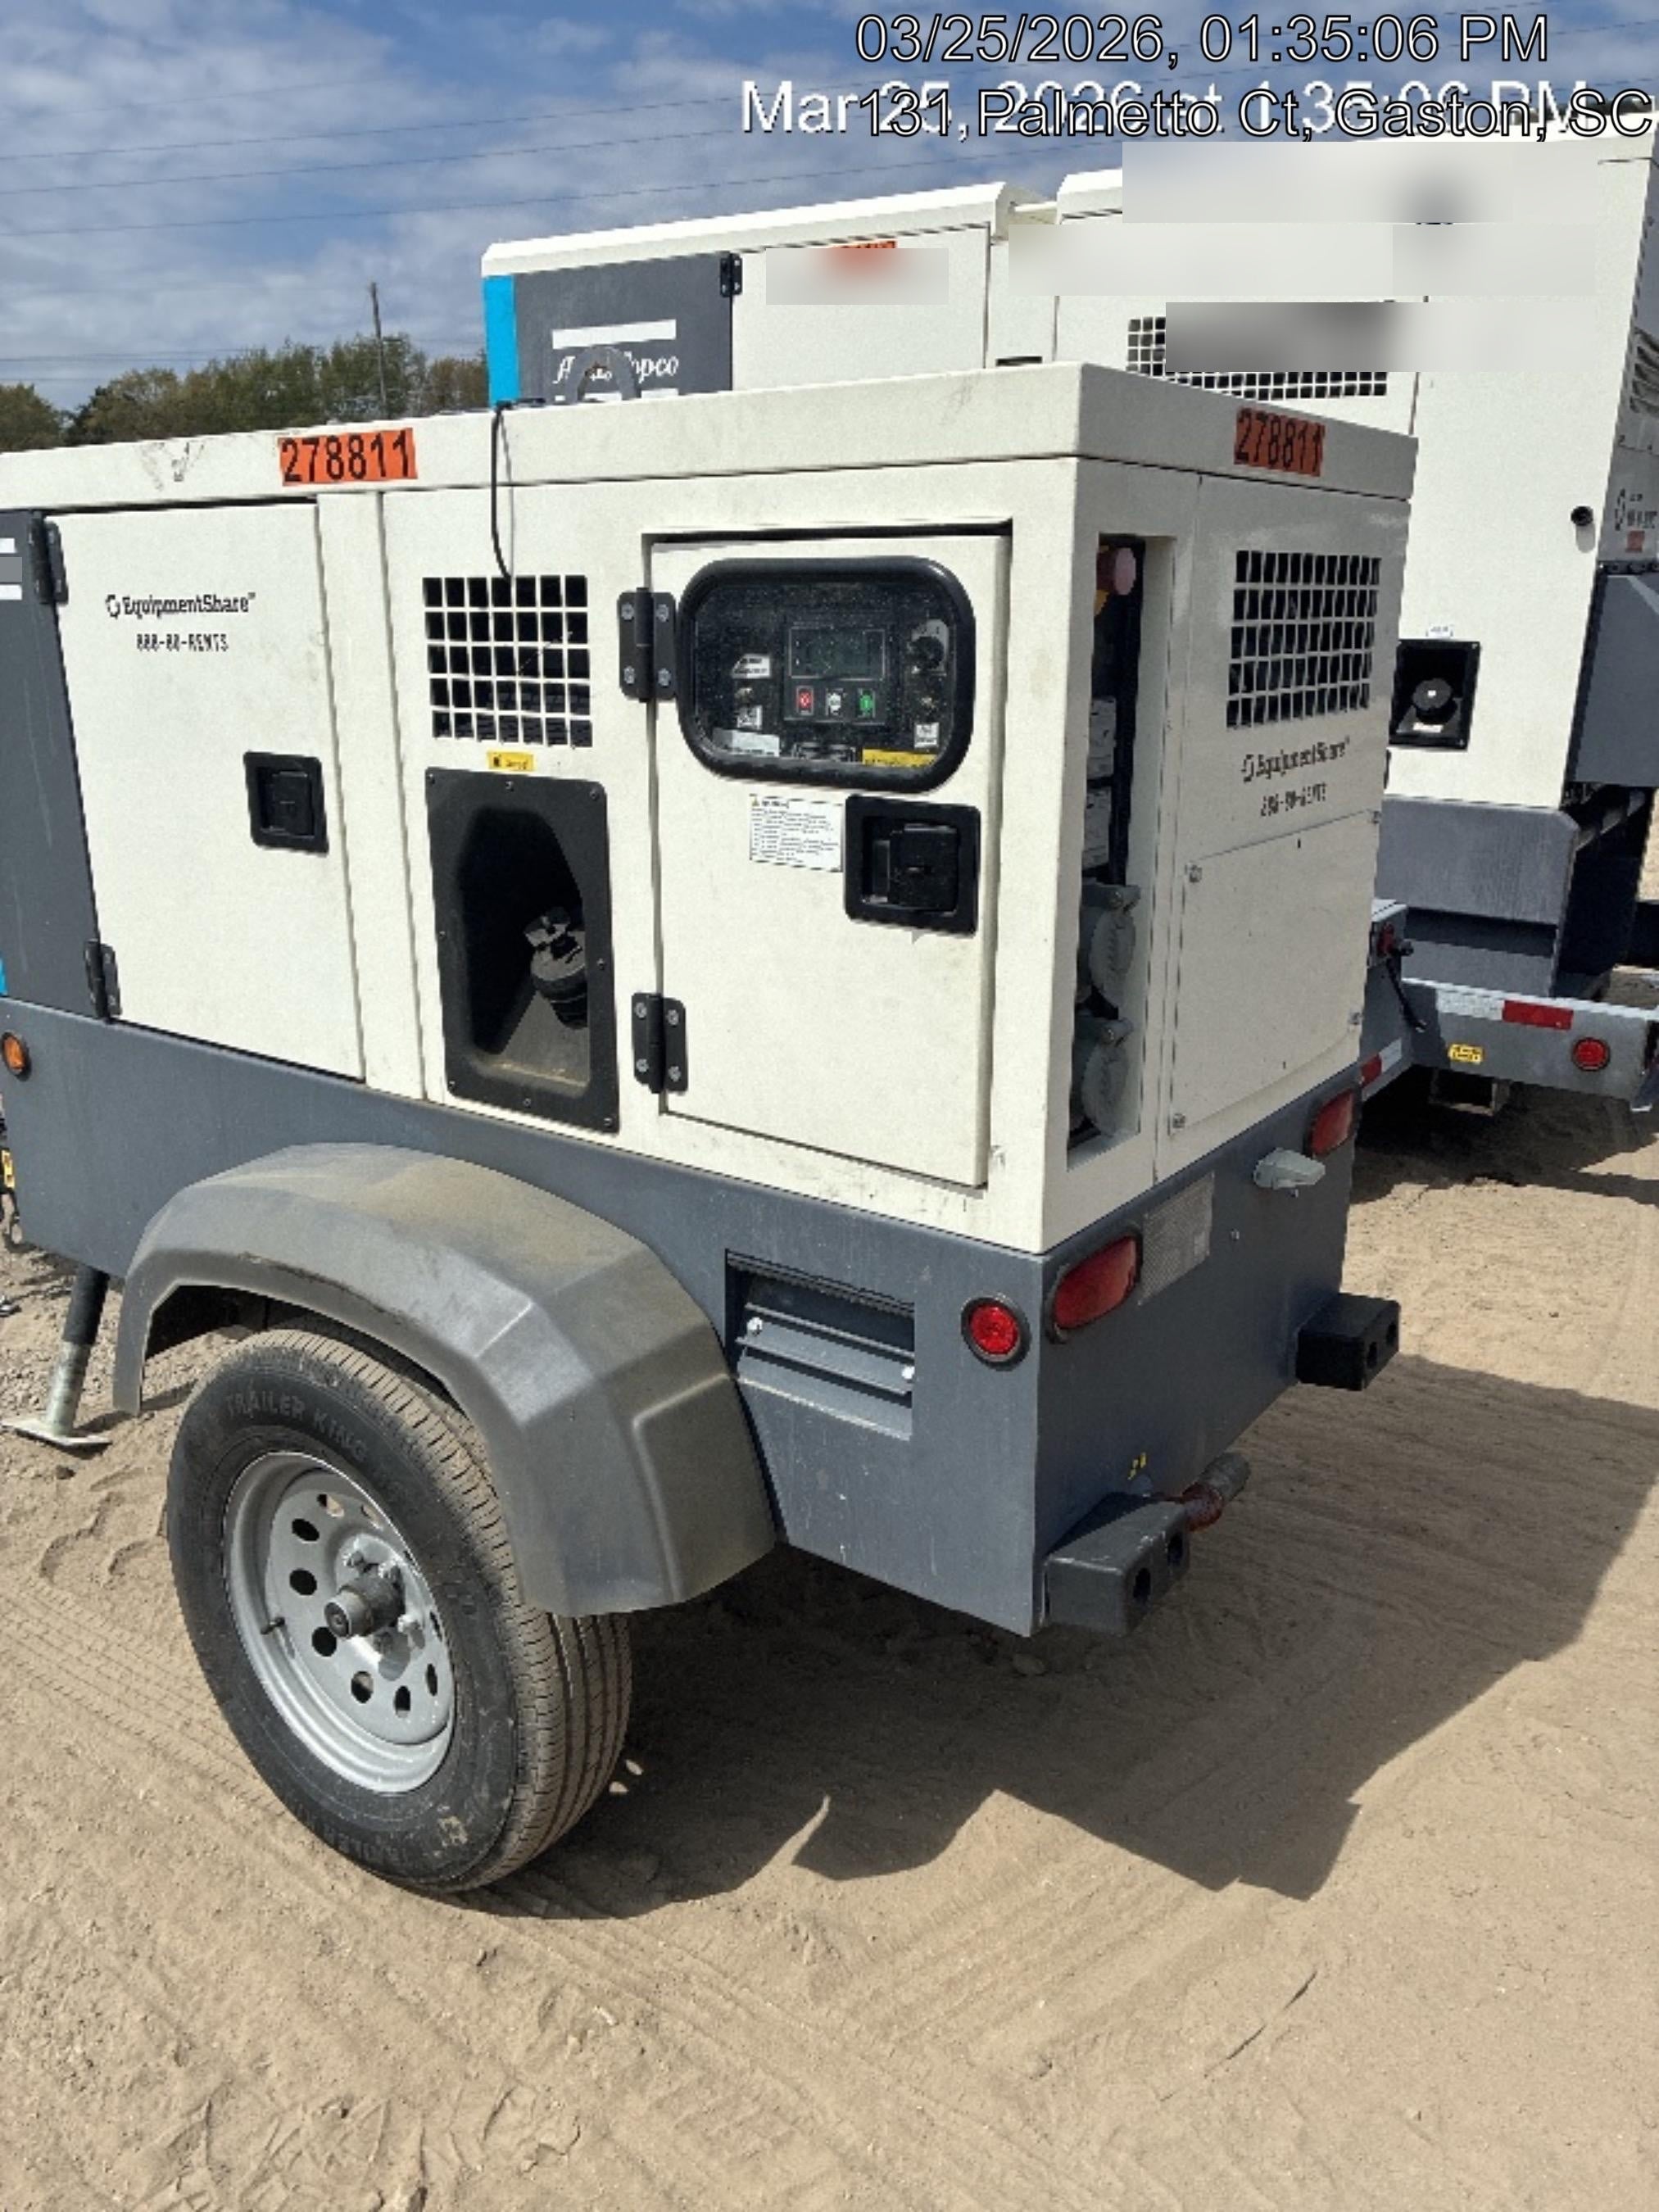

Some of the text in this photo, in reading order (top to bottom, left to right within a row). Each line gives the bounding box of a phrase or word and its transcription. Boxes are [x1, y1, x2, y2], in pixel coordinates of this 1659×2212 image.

[281, 429, 410, 483] 278811
[1235, 407, 1323, 474] 278811
[224, 1389, 368, 1462] TRAILER KING
